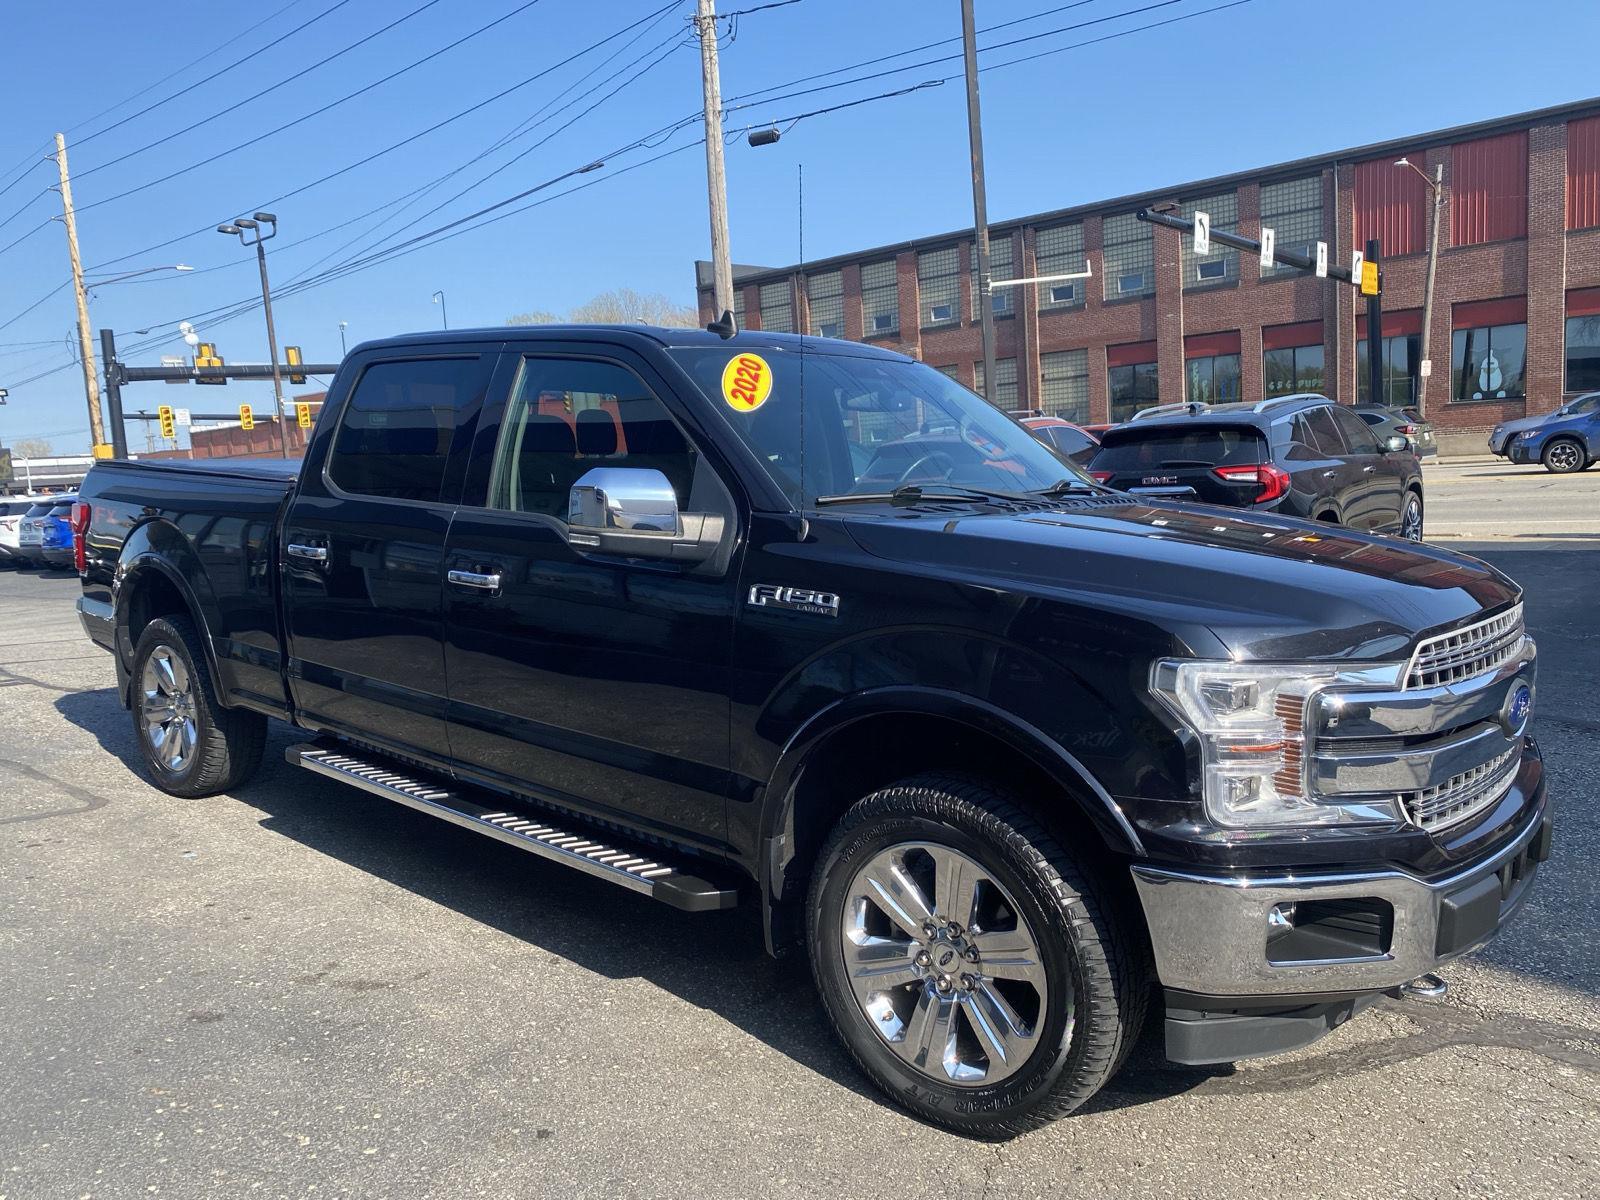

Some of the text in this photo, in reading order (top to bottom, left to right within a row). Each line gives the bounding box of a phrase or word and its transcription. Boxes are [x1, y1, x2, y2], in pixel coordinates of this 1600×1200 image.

[731, 357, 761, 405] 2020
[1141, 475, 1177, 485] GMC
[796, 603, 830, 614] LARIAT
